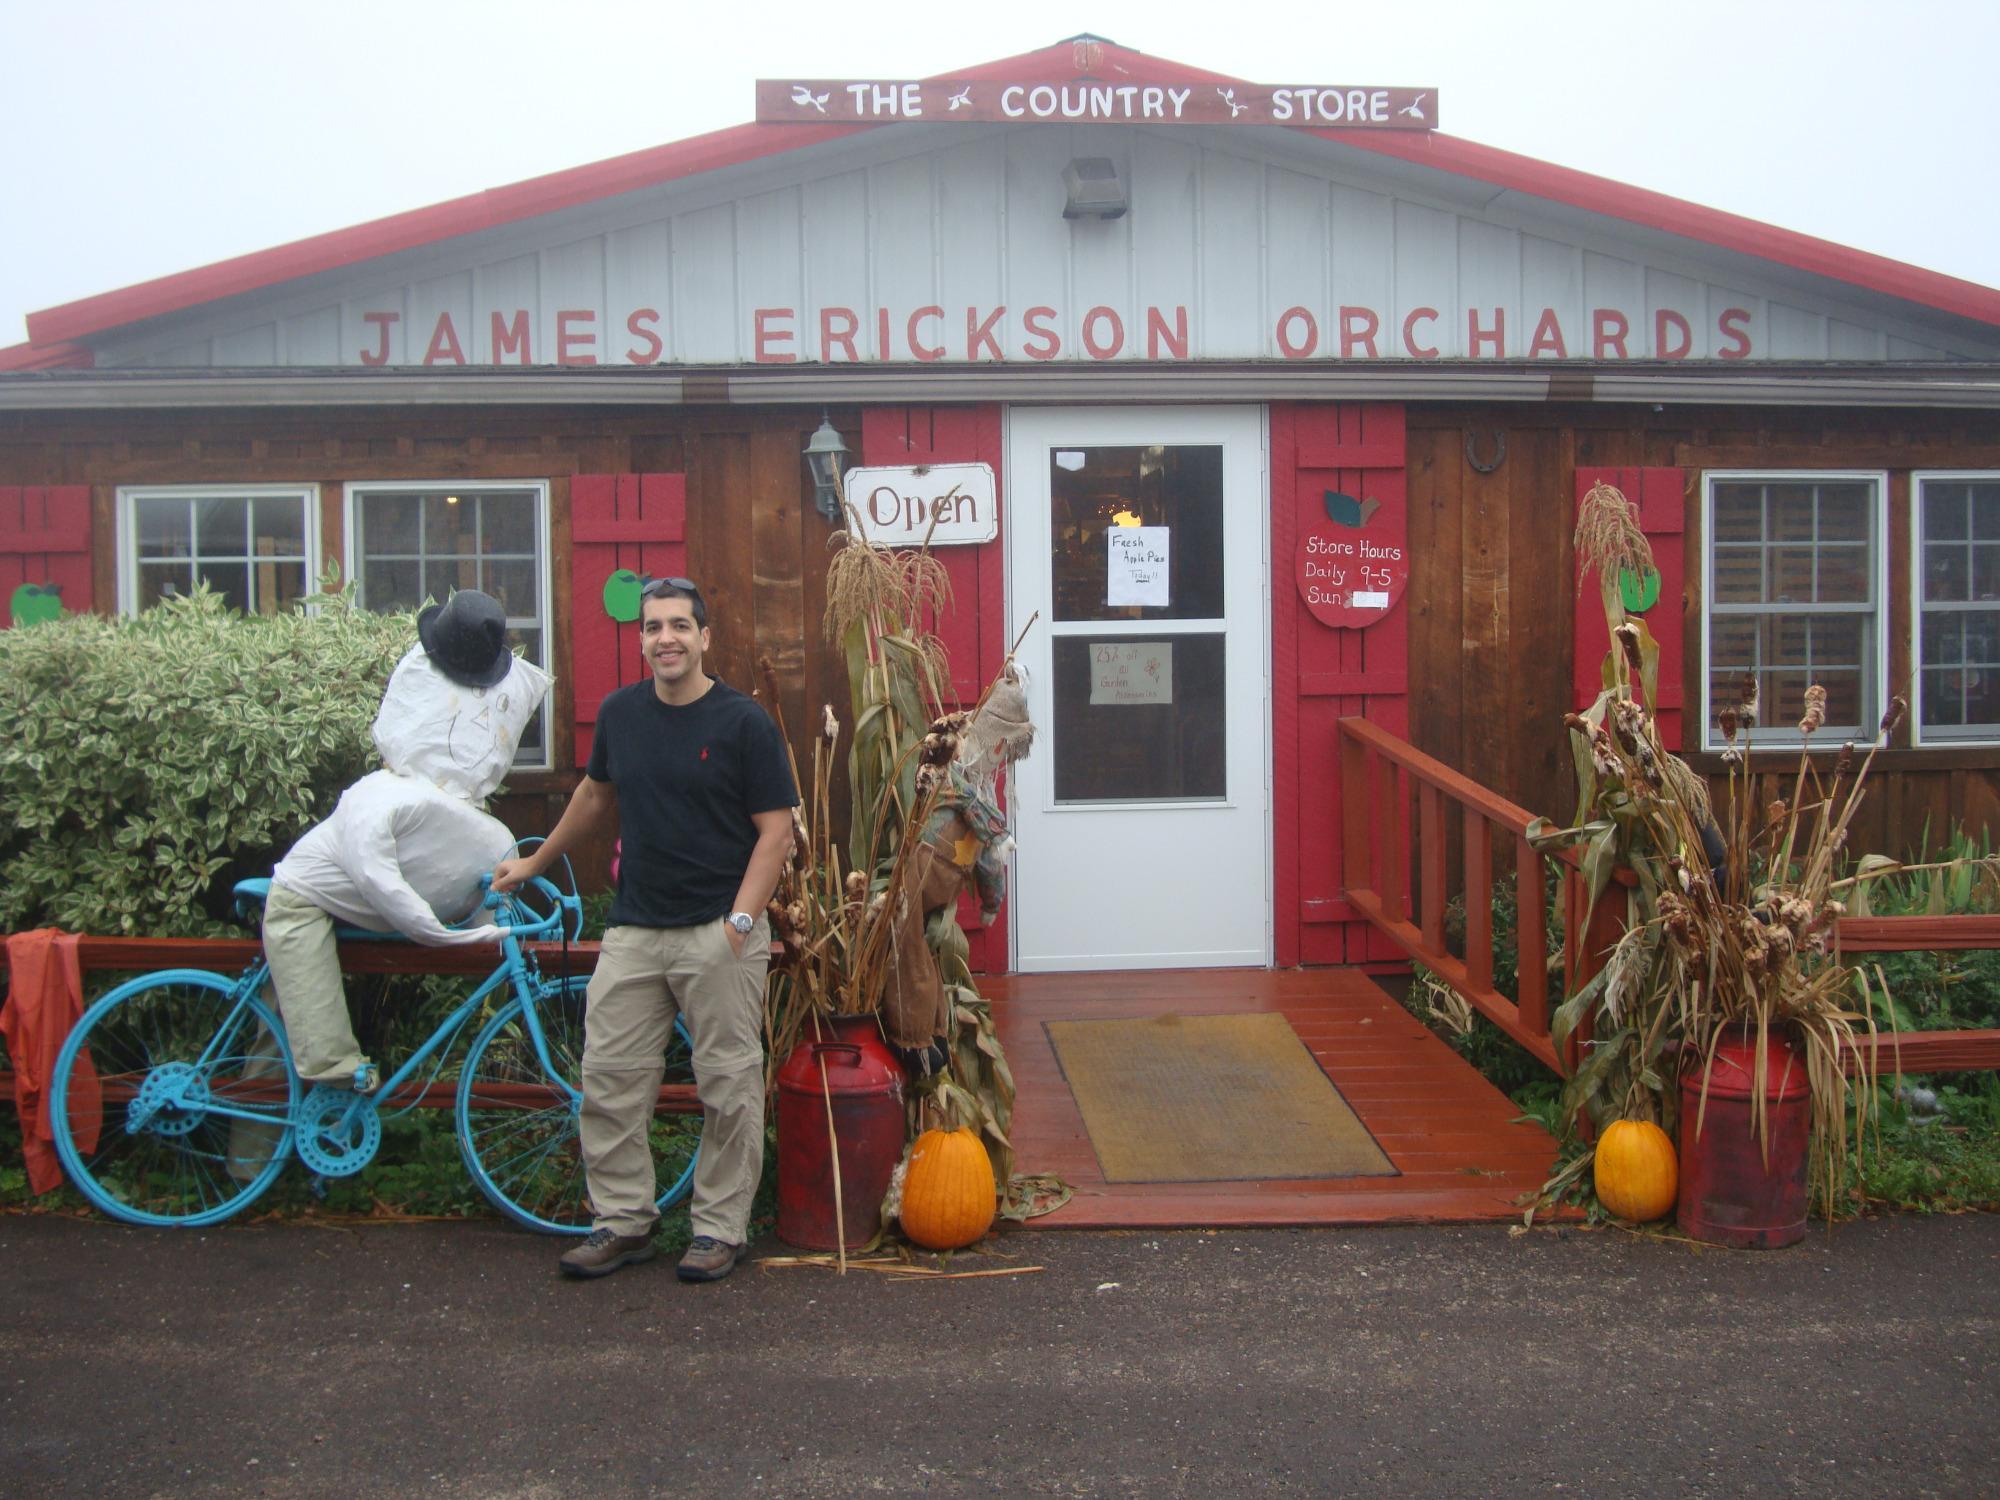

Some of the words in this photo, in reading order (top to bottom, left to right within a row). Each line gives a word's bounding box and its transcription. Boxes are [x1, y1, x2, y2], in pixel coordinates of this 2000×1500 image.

[847, 83, 922, 117] THE
[1001, 85, 1192, 117] COUNTRY
[1272, 89, 1390, 122] STORE
[360, 308, 663, 366] JAMES
[755, 306, 1188, 363] ERICKSON
[1276, 306, 1752, 359] ORCHARDS
[867, 486, 978, 531] Open
[1123, 550, 1145, 565] Apple
[1306, 536, 1353, 555] Store
[1360, 540, 1400, 560] Hours
[1305, 561, 1346, 586] Daily
[1360, 566, 1391, 586] 9-5
[1307, 586, 1341, 605] Sun
